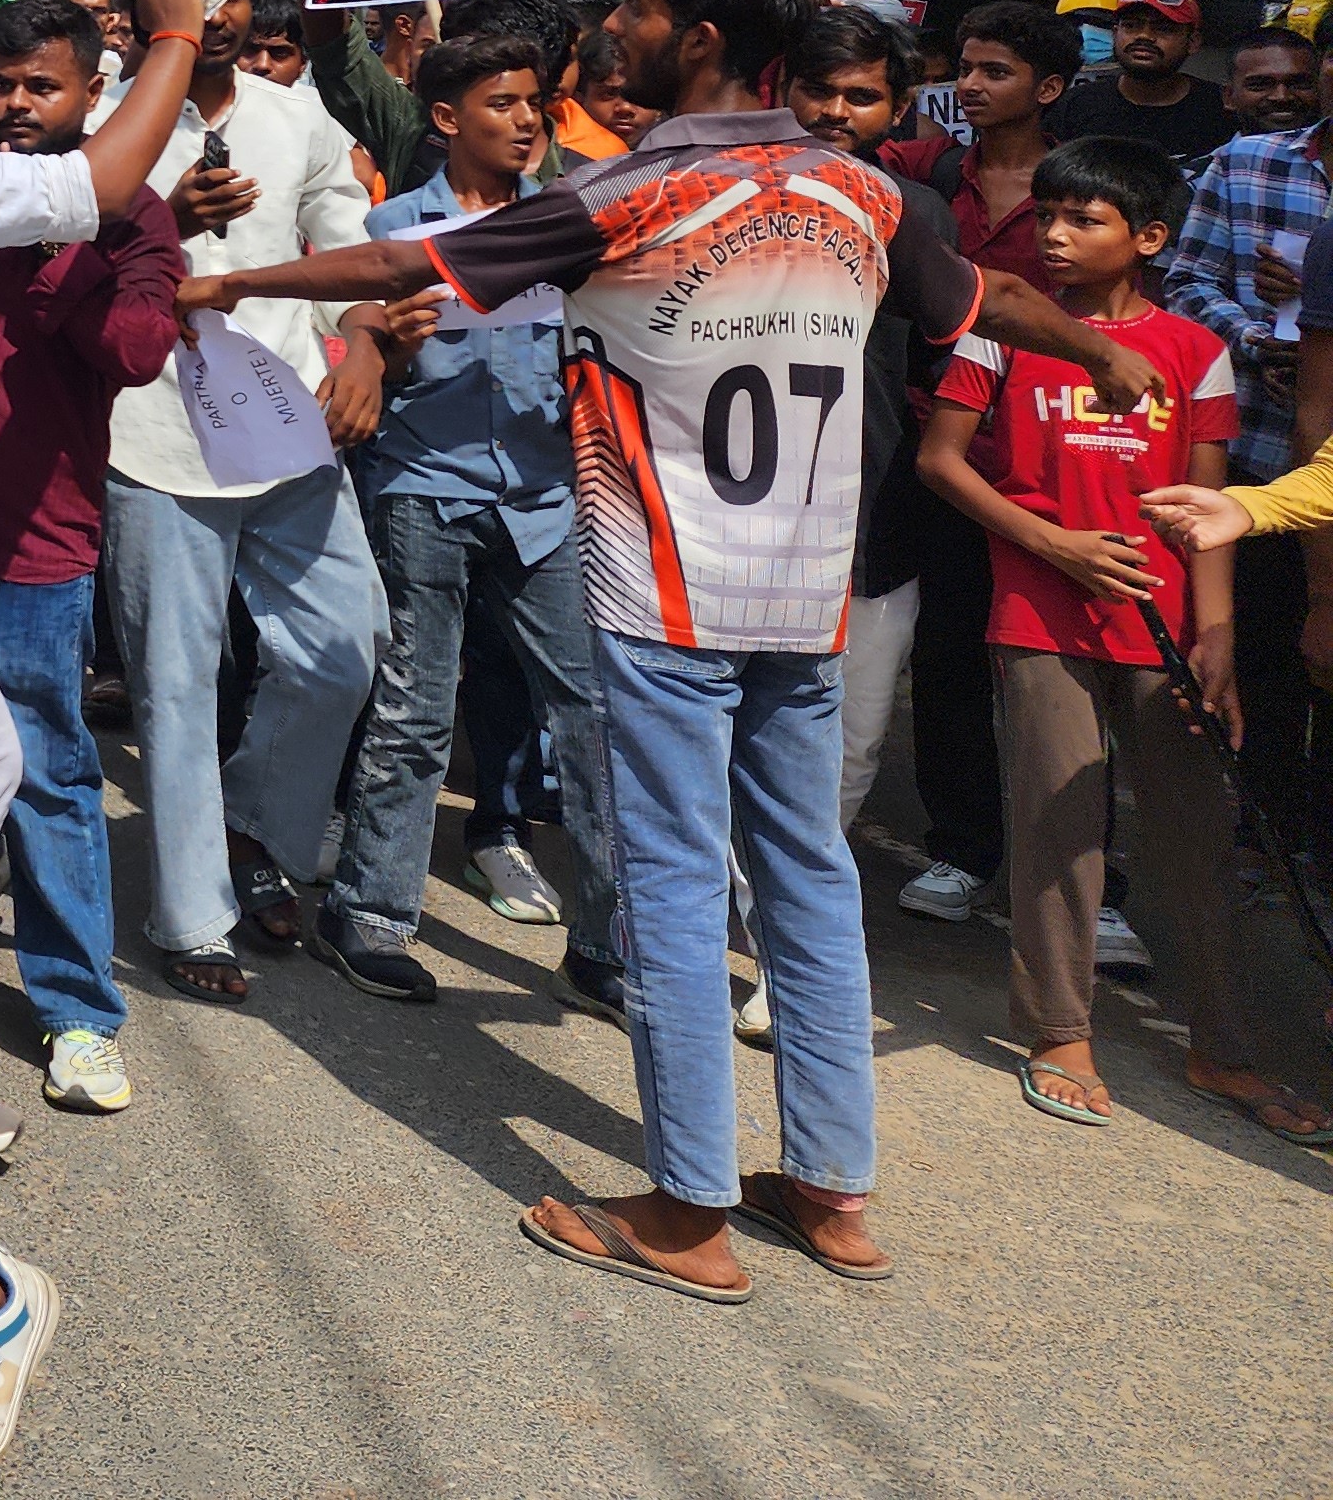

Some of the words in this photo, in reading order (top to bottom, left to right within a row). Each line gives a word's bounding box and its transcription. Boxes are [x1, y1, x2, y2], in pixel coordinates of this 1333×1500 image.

[927, 91, 969, 124] NE
[648, 262, 712, 336] NAYAK
[708, 213, 820, 267] DEFENCE
[823, 229, 864, 290] ACAD
[691, 311, 795, 342] PACHRUKHI
[231, 392, 248, 405] O
[702, 362, 845, 506] 07
